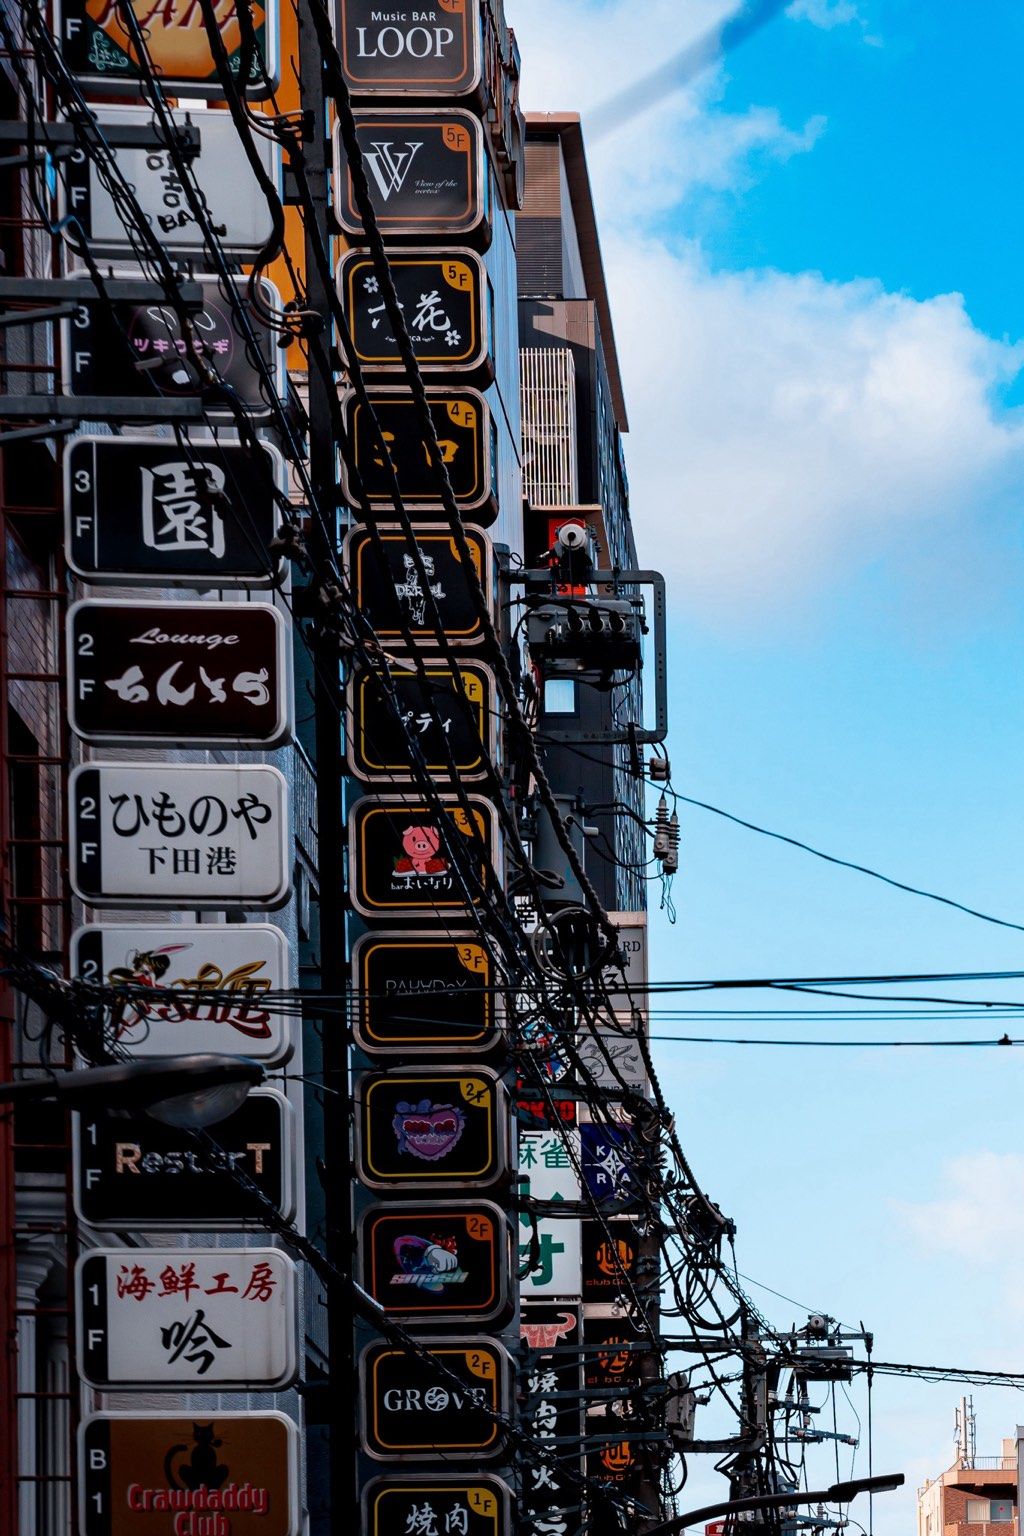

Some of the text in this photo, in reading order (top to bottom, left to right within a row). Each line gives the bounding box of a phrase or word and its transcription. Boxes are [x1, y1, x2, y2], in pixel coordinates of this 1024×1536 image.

[371, 12, 436, 21] Music BAR
[356, 27, 454, 58] LOOP
[447, 127, 465, 148] 5F
[448, 265, 467, 287] 5F
[451, 403, 473, 424] 4F
[139, 461, 226, 559] 園
[129, 628, 240, 650] Lounge
[78, 634, 95, 700] 2F
[79, 797, 97, 863] 2F
[108, 791, 272, 840] ひものや
[139, 847, 237, 876] 下田港
[463, 949, 482, 968] 3F
[470, 1218, 489, 1237] 2F
[117, 1262, 277, 1301] 海鮮工房
[88, 1284, 104, 1350] 1F
[160, 1309, 232, 1374] 吟
[472, 1355, 490, 1374] 2F
[90, 1449, 107, 1513] B1
[127, 1483, 270, 1515] Crawdaddy
[474, 1493, 491, 1512] 1F
[405, 1502, 469, 1536] 焼肉
